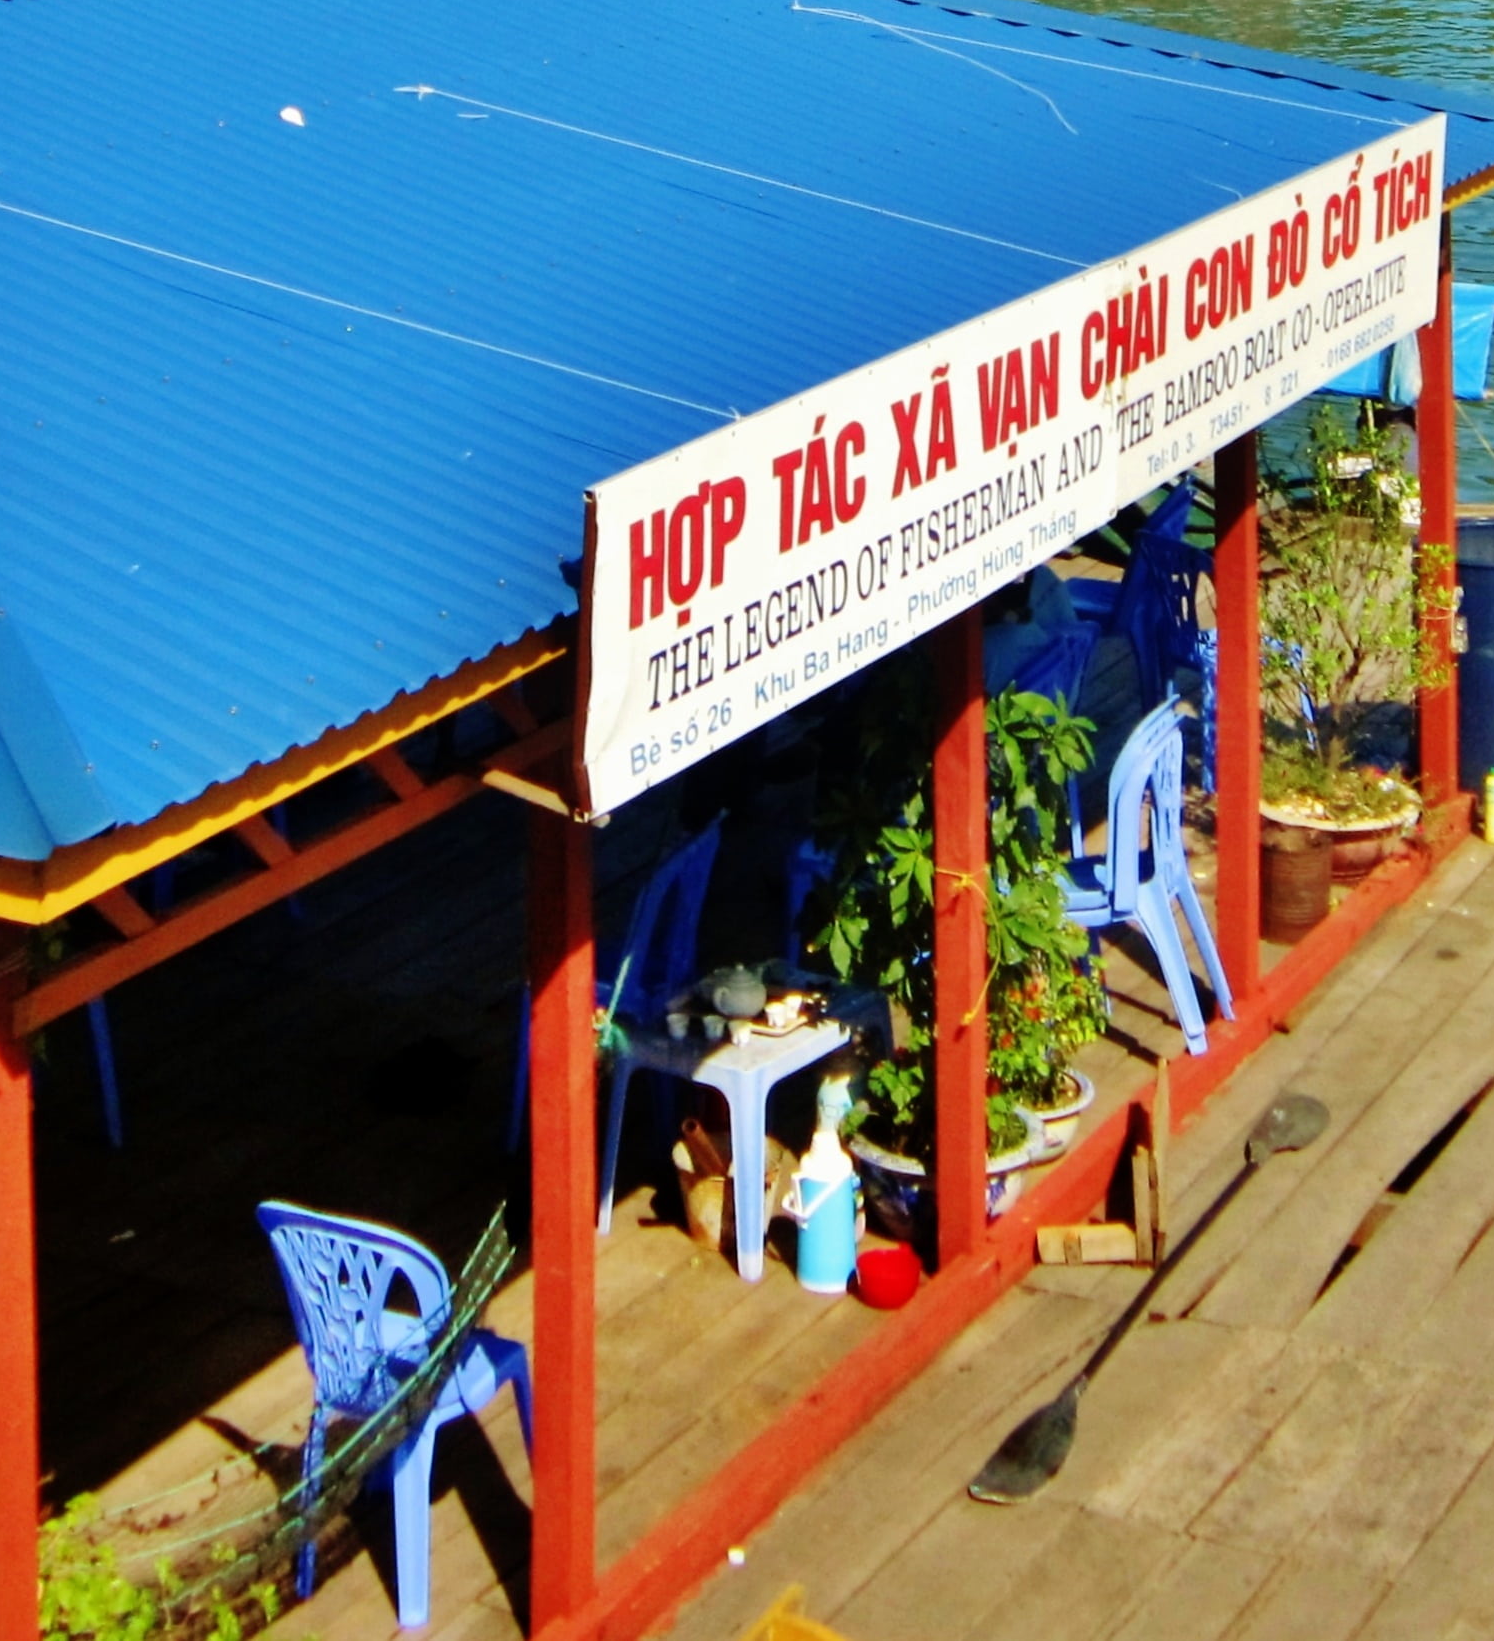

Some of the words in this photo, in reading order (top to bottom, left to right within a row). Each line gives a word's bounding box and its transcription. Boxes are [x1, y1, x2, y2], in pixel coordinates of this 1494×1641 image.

[629, 476, 746, 630] HỢP
[773, 414, 866, 554] TÁC
[891, 363, 956, 499] XÃ
[977, 331, 1059, 458] VẠN
[1081, 265, 1168, 400] CHÀI
[1184, 234, 1253, 340] CON
[1267, 193, 1309, 299] ĐÒ
[1322, 153, 1364, 268] CỔ
[1373, 149, 1432, 244] TÍCH
[648, 626, 714, 711] THE
[724, 560, 848, 674] LEGEND
[857, 535, 892, 600] OF
[899, 454, 1046, 579] FISHERMAN
[1057, 424, 1103, 492] AND
[1117, 392, 1154, 453] THE
[1164, 345, 1238, 427] BAMBOO
[1244, 319, 1287, 381] BOAT
[707, 698, 732, 735] 26
[755, 669, 795, 709] Khu
[804, 650, 829, 681] Ba
[838, 619, 889, 663] Hang
